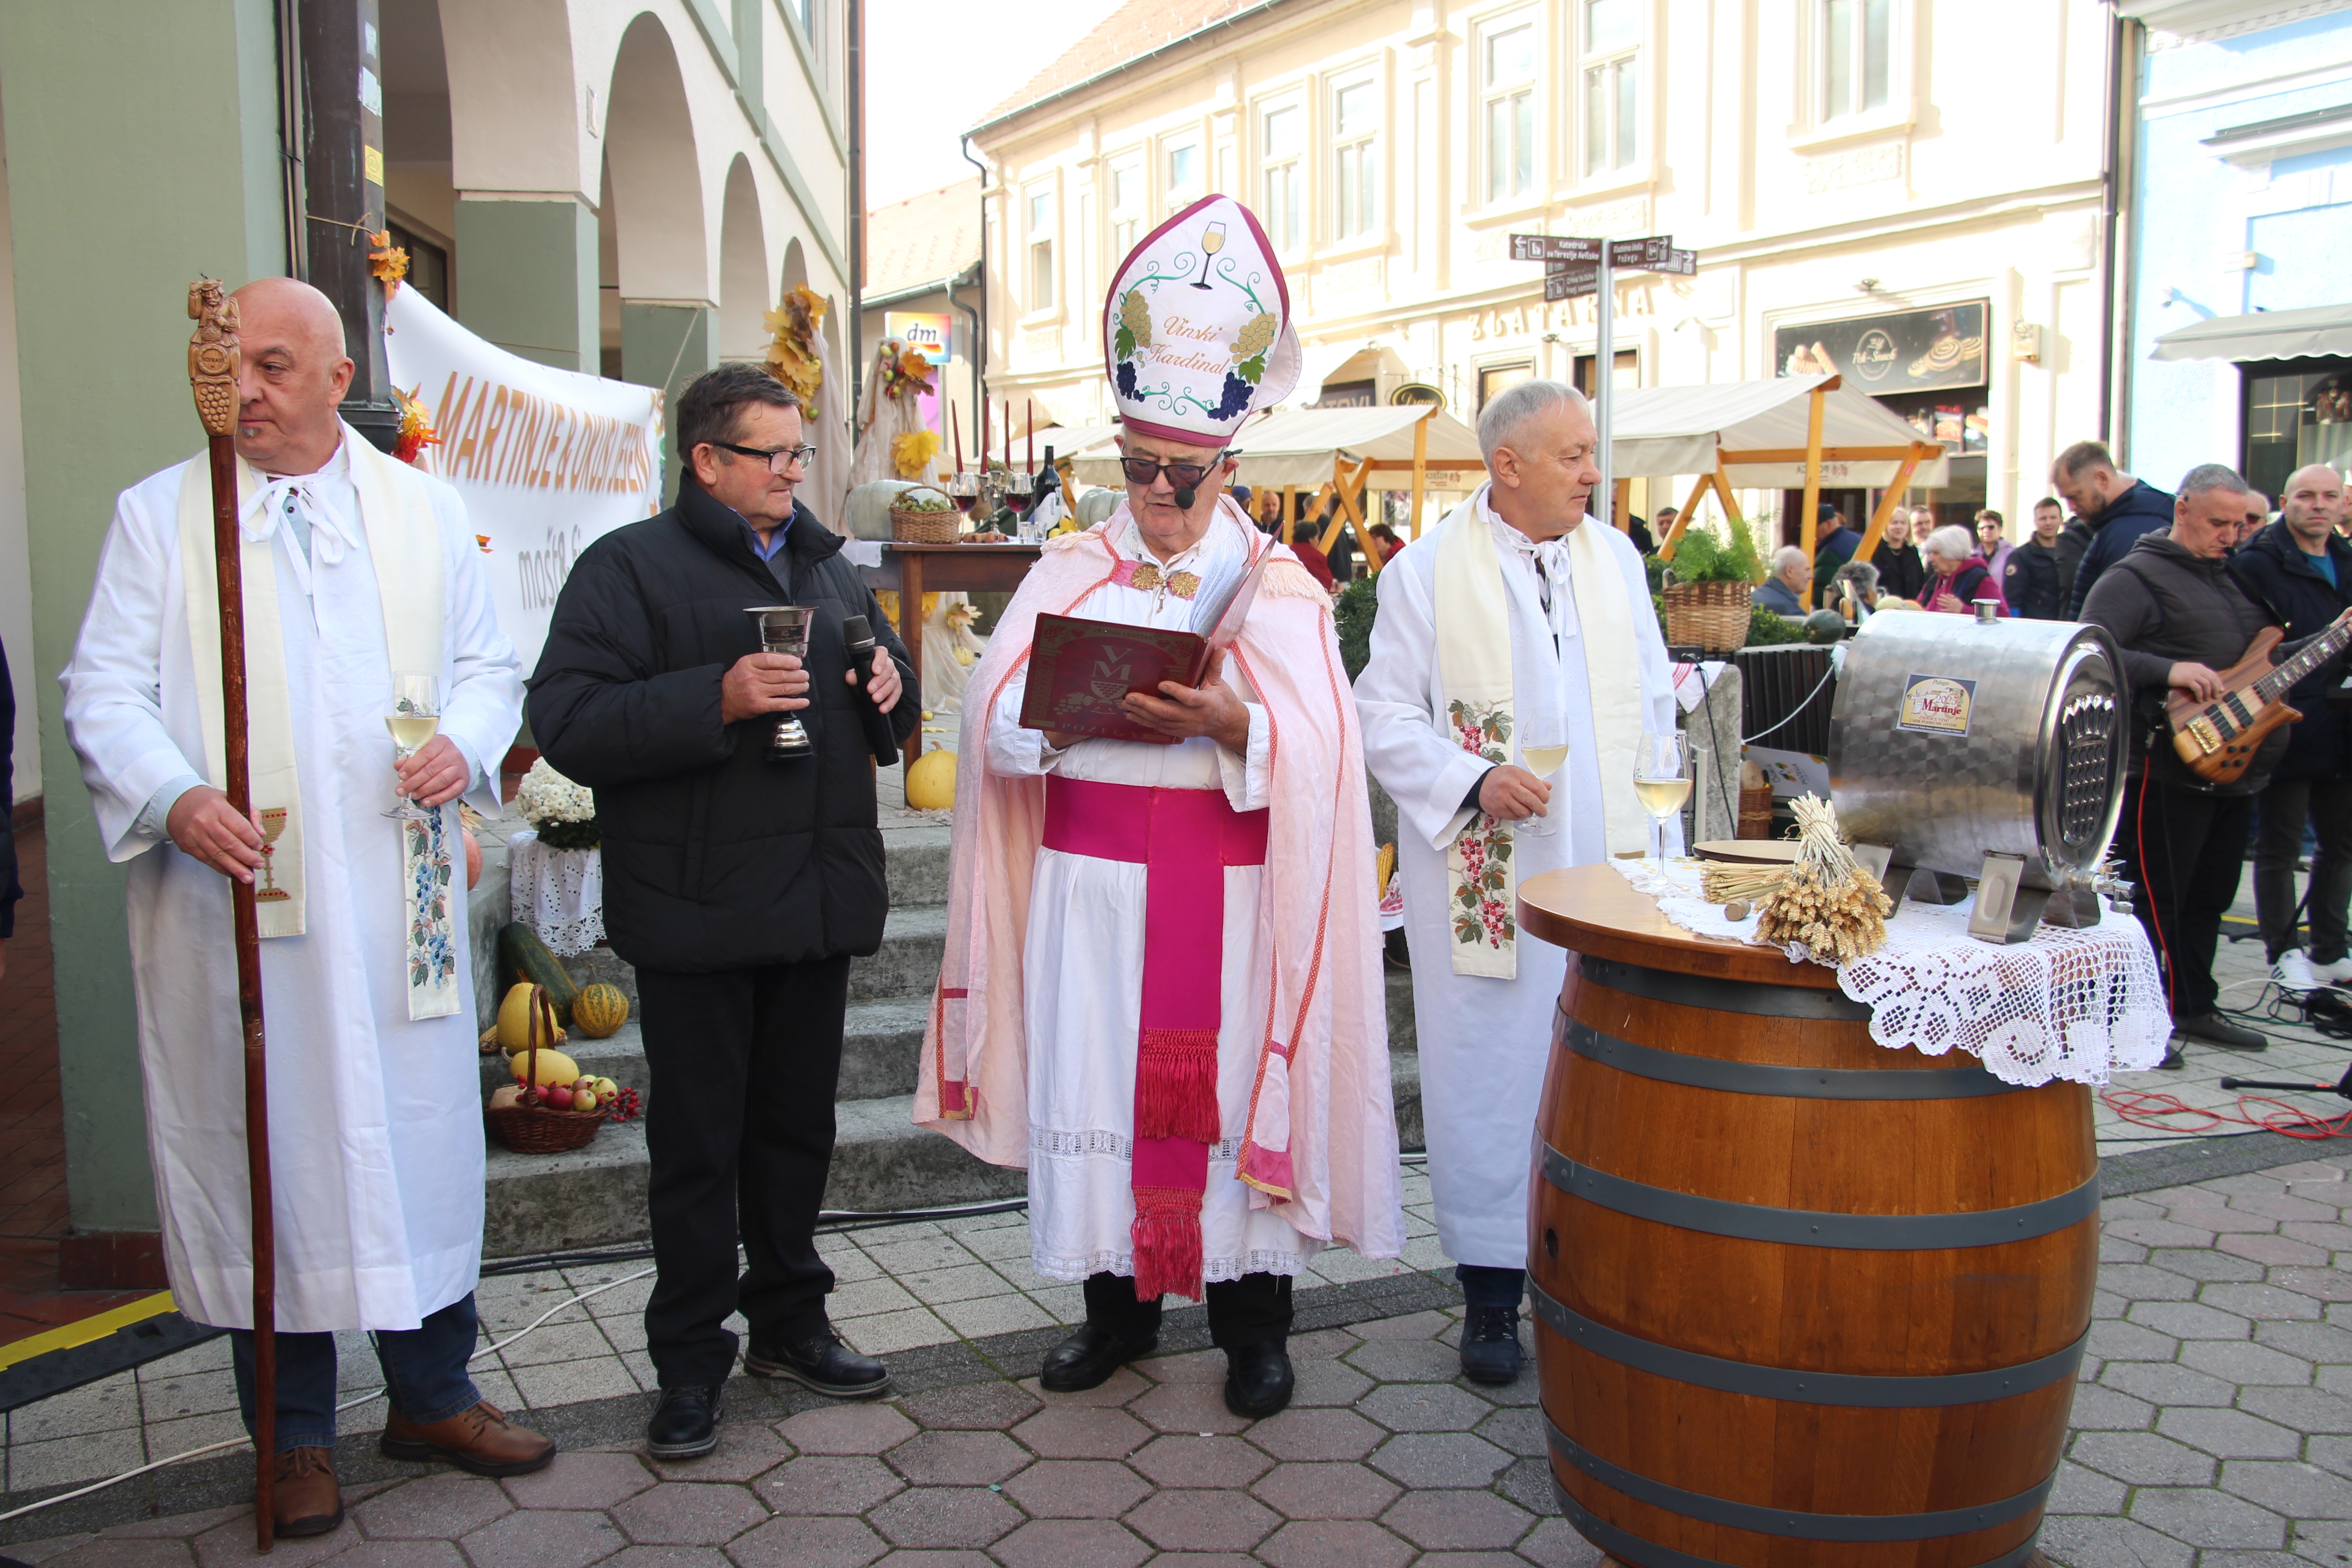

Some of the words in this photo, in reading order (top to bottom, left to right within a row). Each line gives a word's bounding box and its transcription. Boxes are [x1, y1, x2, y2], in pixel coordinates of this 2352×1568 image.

[1558, 241, 1587, 250] Katedrala
[906, 323, 937, 342] dm
[1163, 316, 1223, 343] Vinski
[1145, 343, 1230, 375] Kardinal
[431, 371, 564, 487] MARTINJE
[554, 407, 577, 489] &
[518, 525, 561, 611] mošt
[1101, 644, 1134, 664] V
[1089, 661, 1134, 681] M
[1921, 698, 1961, 715] Martinje
[1935, 695, 1957, 705] 2025
